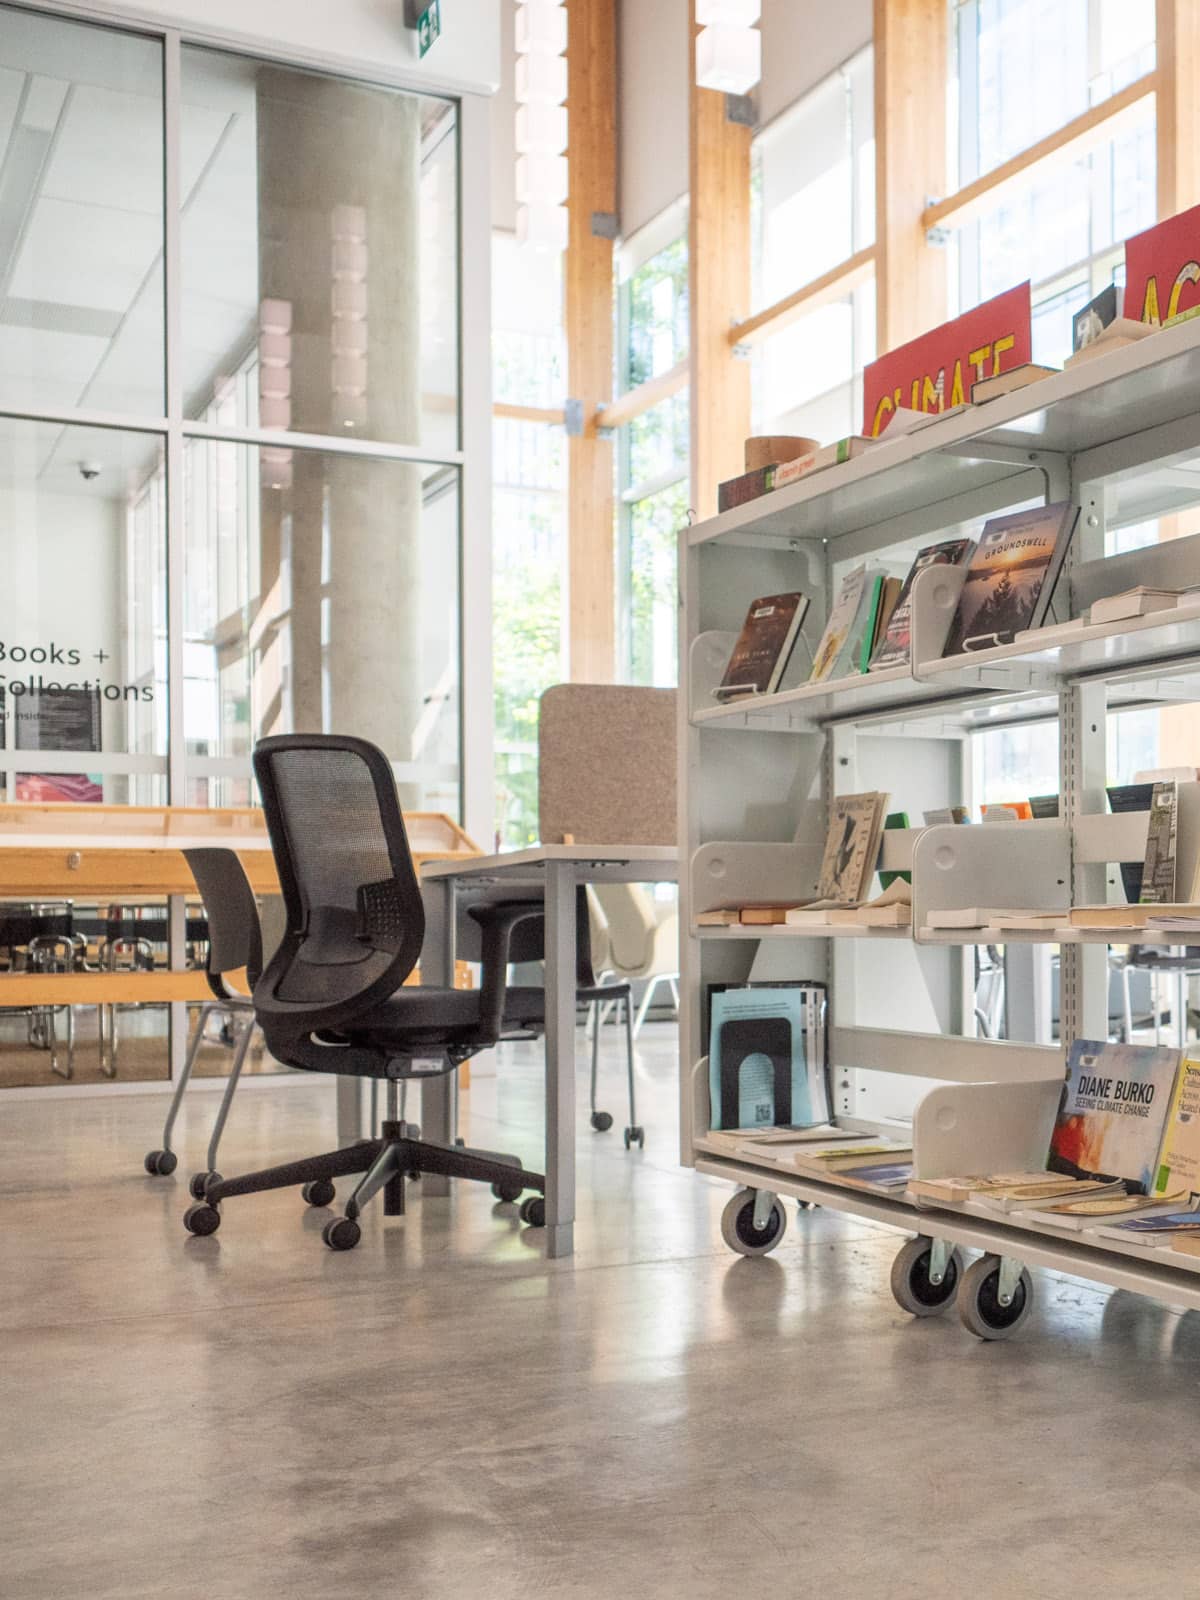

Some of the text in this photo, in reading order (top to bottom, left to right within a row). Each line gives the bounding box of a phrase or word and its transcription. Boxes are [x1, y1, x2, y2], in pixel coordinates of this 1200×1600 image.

[871, 332, 1015, 440] CIMAT
[984, 536, 1047, 560] GROUNDSWELL
[1077, 1075, 1155, 1104] DIANE BURKO
[1074, 1096, 1151, 1118] SEEING CLIMATE CHANGE
